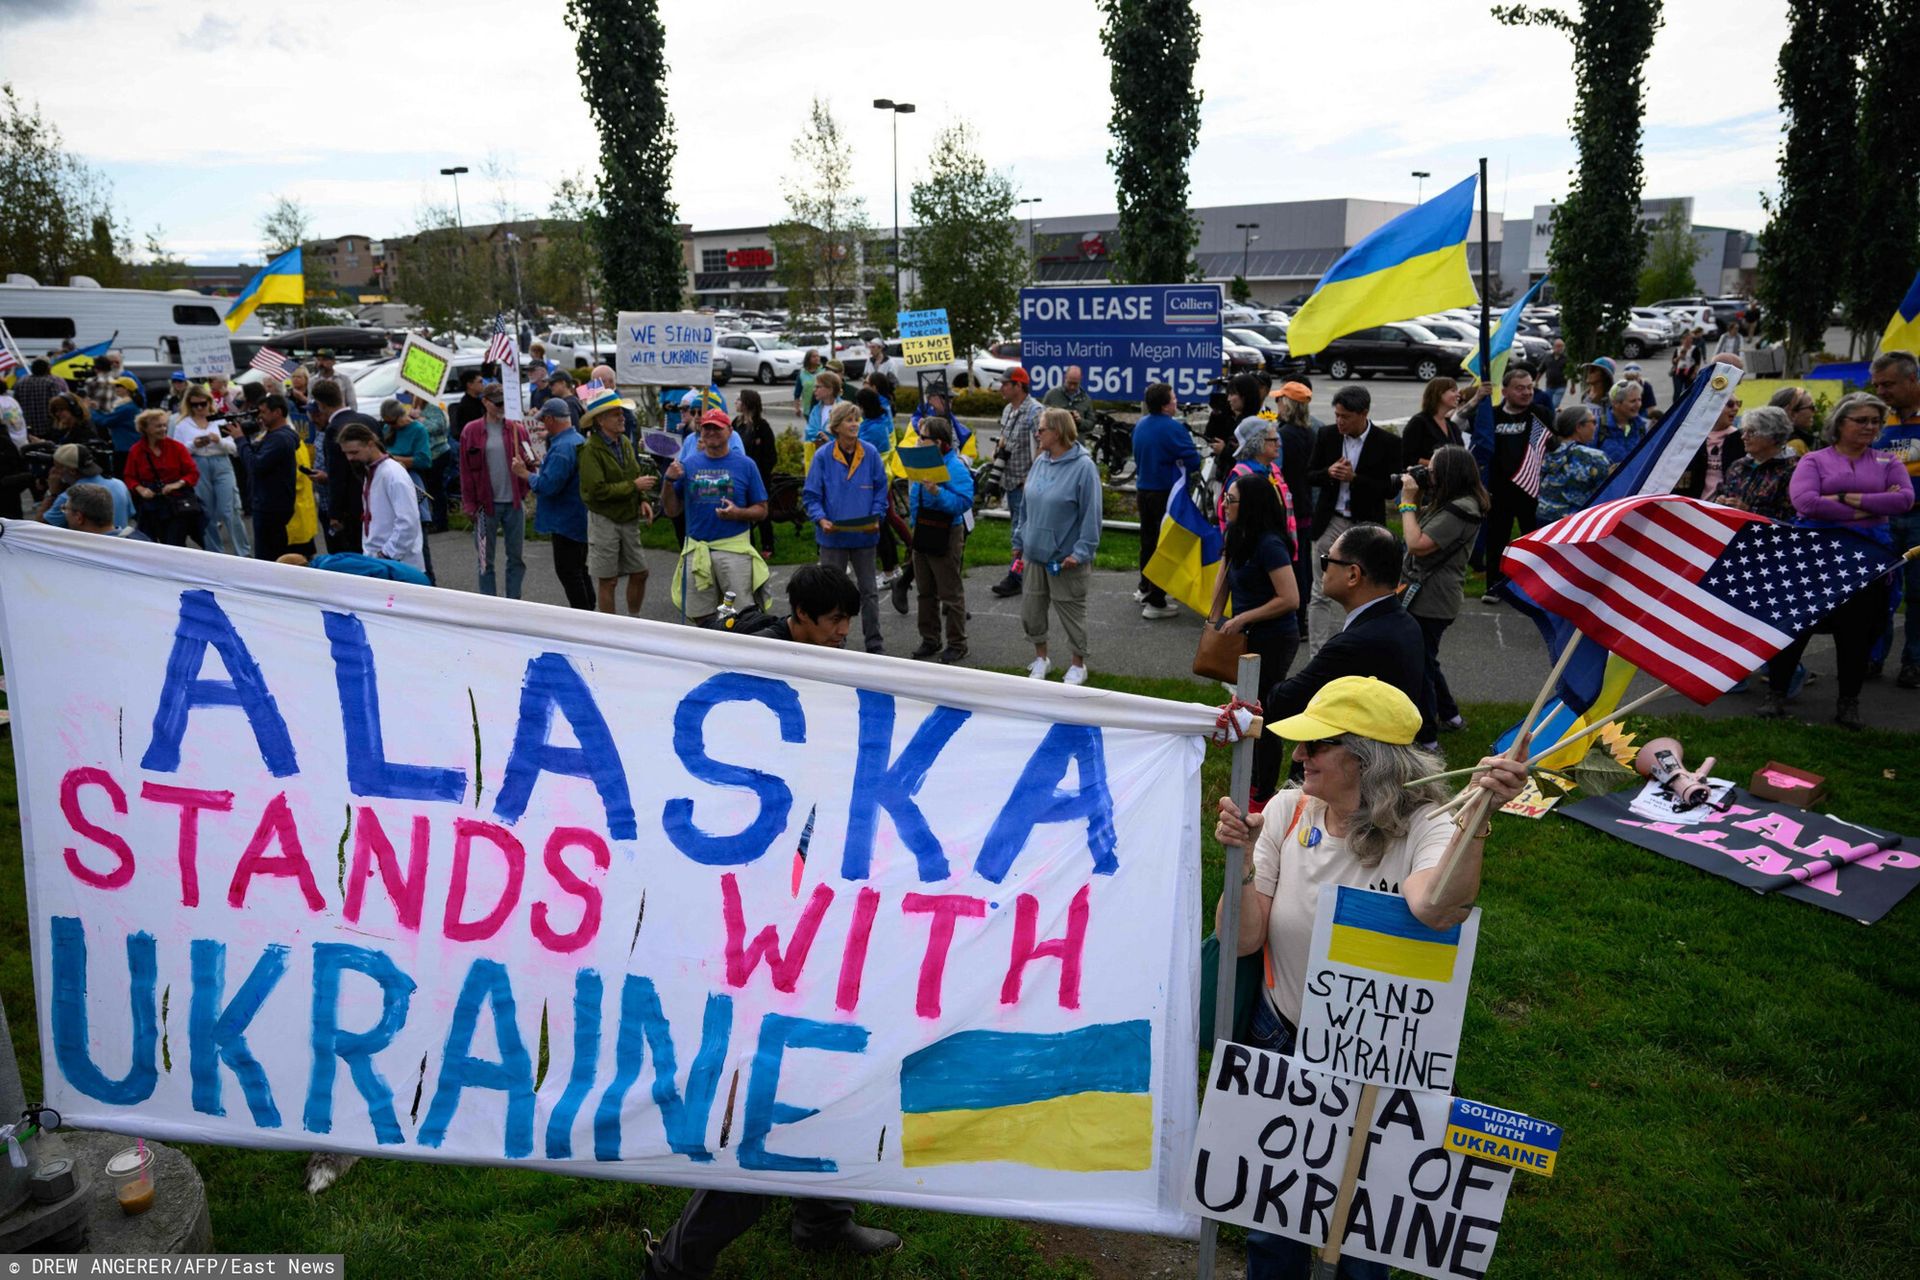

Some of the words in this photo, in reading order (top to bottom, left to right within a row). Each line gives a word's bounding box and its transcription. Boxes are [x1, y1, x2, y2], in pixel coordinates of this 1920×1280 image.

[1023, 297, 1072, 321] FOR
[1078, 296, 1153, 321] LEASE
[1170, 297, 1214, 311] Colliers
[630, 324, 656, 345] WE
[664, 325, 713, 343] STAND
[905, 340, 924, 350] IT'S
[927, 336, 950, 348] NOT
[910, 327, 944, 337] DECIDE
[661, 349, 709, 365] UKRAINE
[906, 349, 952, 365] JUSTICE
[1023, 341, 1062, 358] Elisha
[1066, 341, 1113, 358] Martin
[1130, 341, 1182, 362] Megan
[1186, 341, 1221, 360] Mills
[1030, 364, 1068, 391] 90
[1087, 365, 1134, 394] 561
[1145, 366, 1214, 397] 5155
[140, 589, 1120, 884] ALASKA
[59, 766, 611, 954] STANDS
[720, 872, 1091, 1019] WITH
[1307, 970, 1435, 1015] STAND
[1325, 1002, 1420, 1051] WITH
[50, 915, 872, 1174] UKRAINE
[1301, 1027, 1453, 1090] UKRAINE
[1215, 1044, 1425, 1141] RUSSA
[1460, 1103, 1557, 1136] SOLIDARITY
[1484, 1121, 1526, 1142] WITH
[1257, 1114, 1383, 1181] OUT
[1408, 1147, 1513, 1211] OF
[1452, 1132, 1549, 1169] UKRAINE
[1194, 1148, 1501, 1280] UKRAINE
